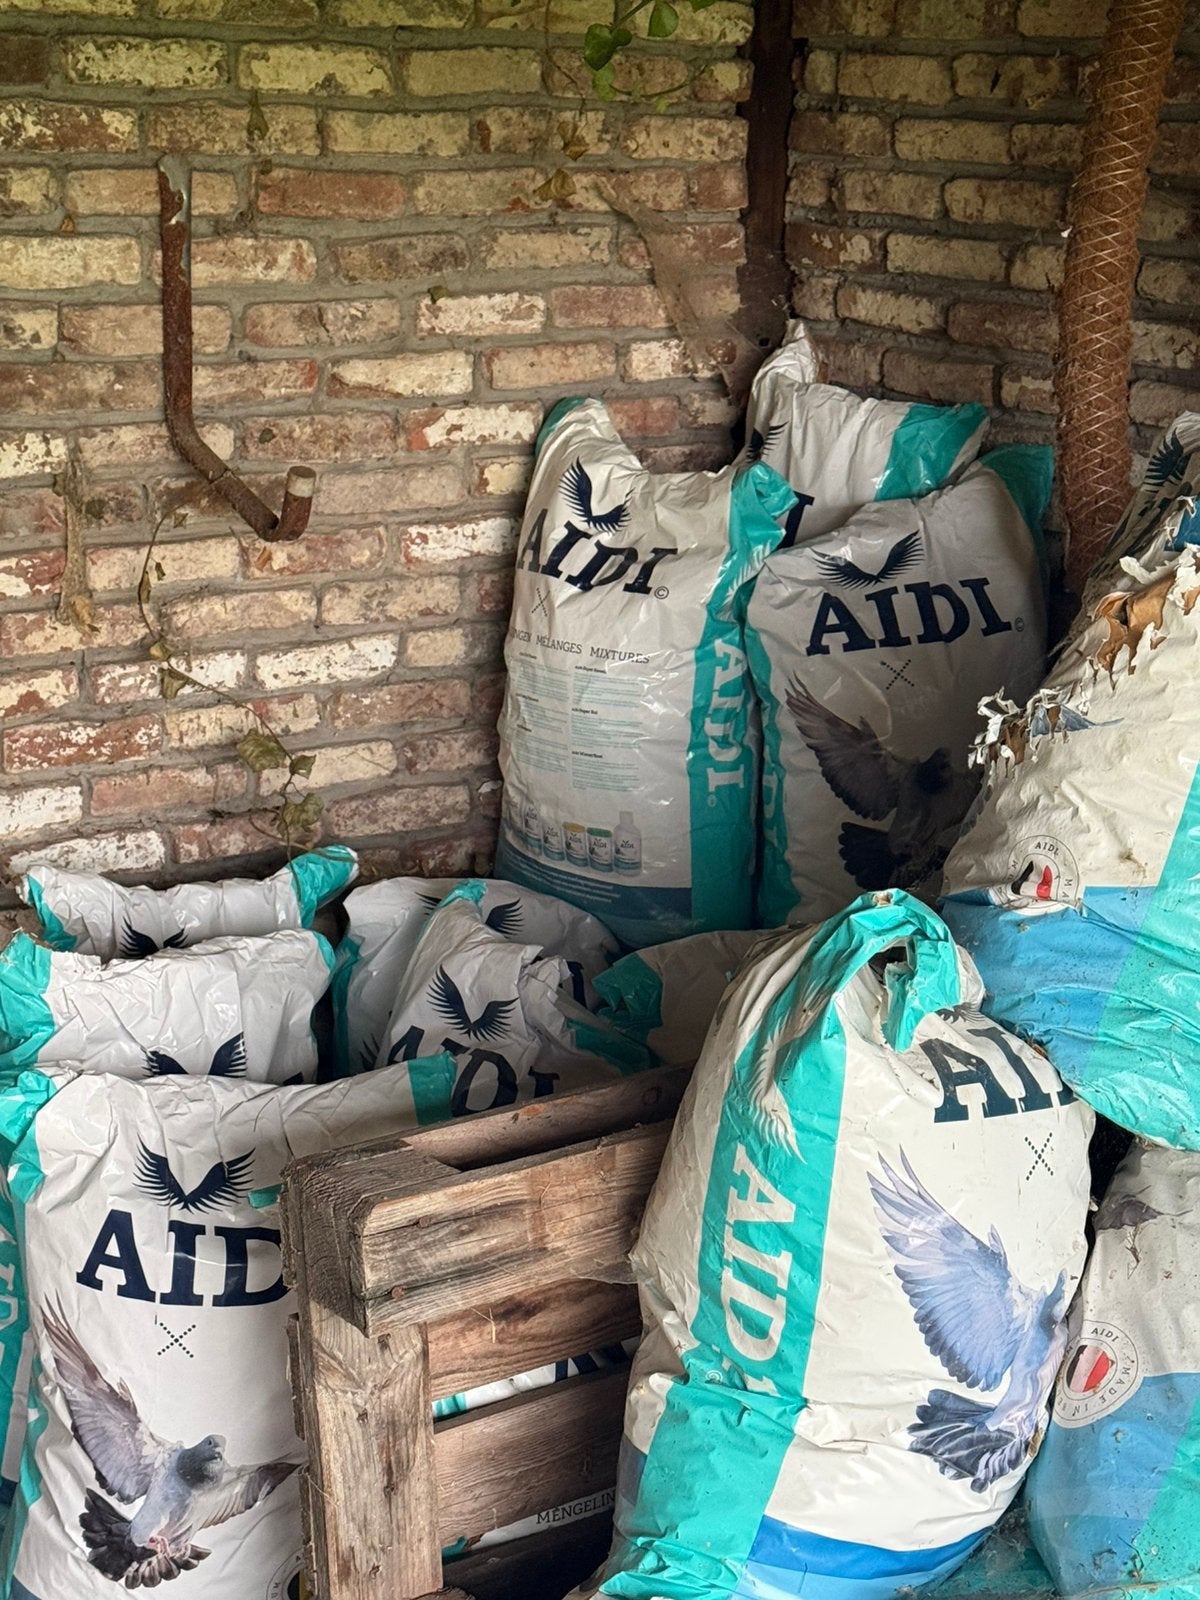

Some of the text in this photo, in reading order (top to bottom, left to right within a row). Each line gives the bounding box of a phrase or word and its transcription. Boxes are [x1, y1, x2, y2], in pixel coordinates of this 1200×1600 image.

[517, 508, 678, 594] AIDI
[805, 577, 1012, 656] AIDI
[589, 646, 650, 664] MIXTURES
[1091, 1326, 1119, 1343] AIDI
